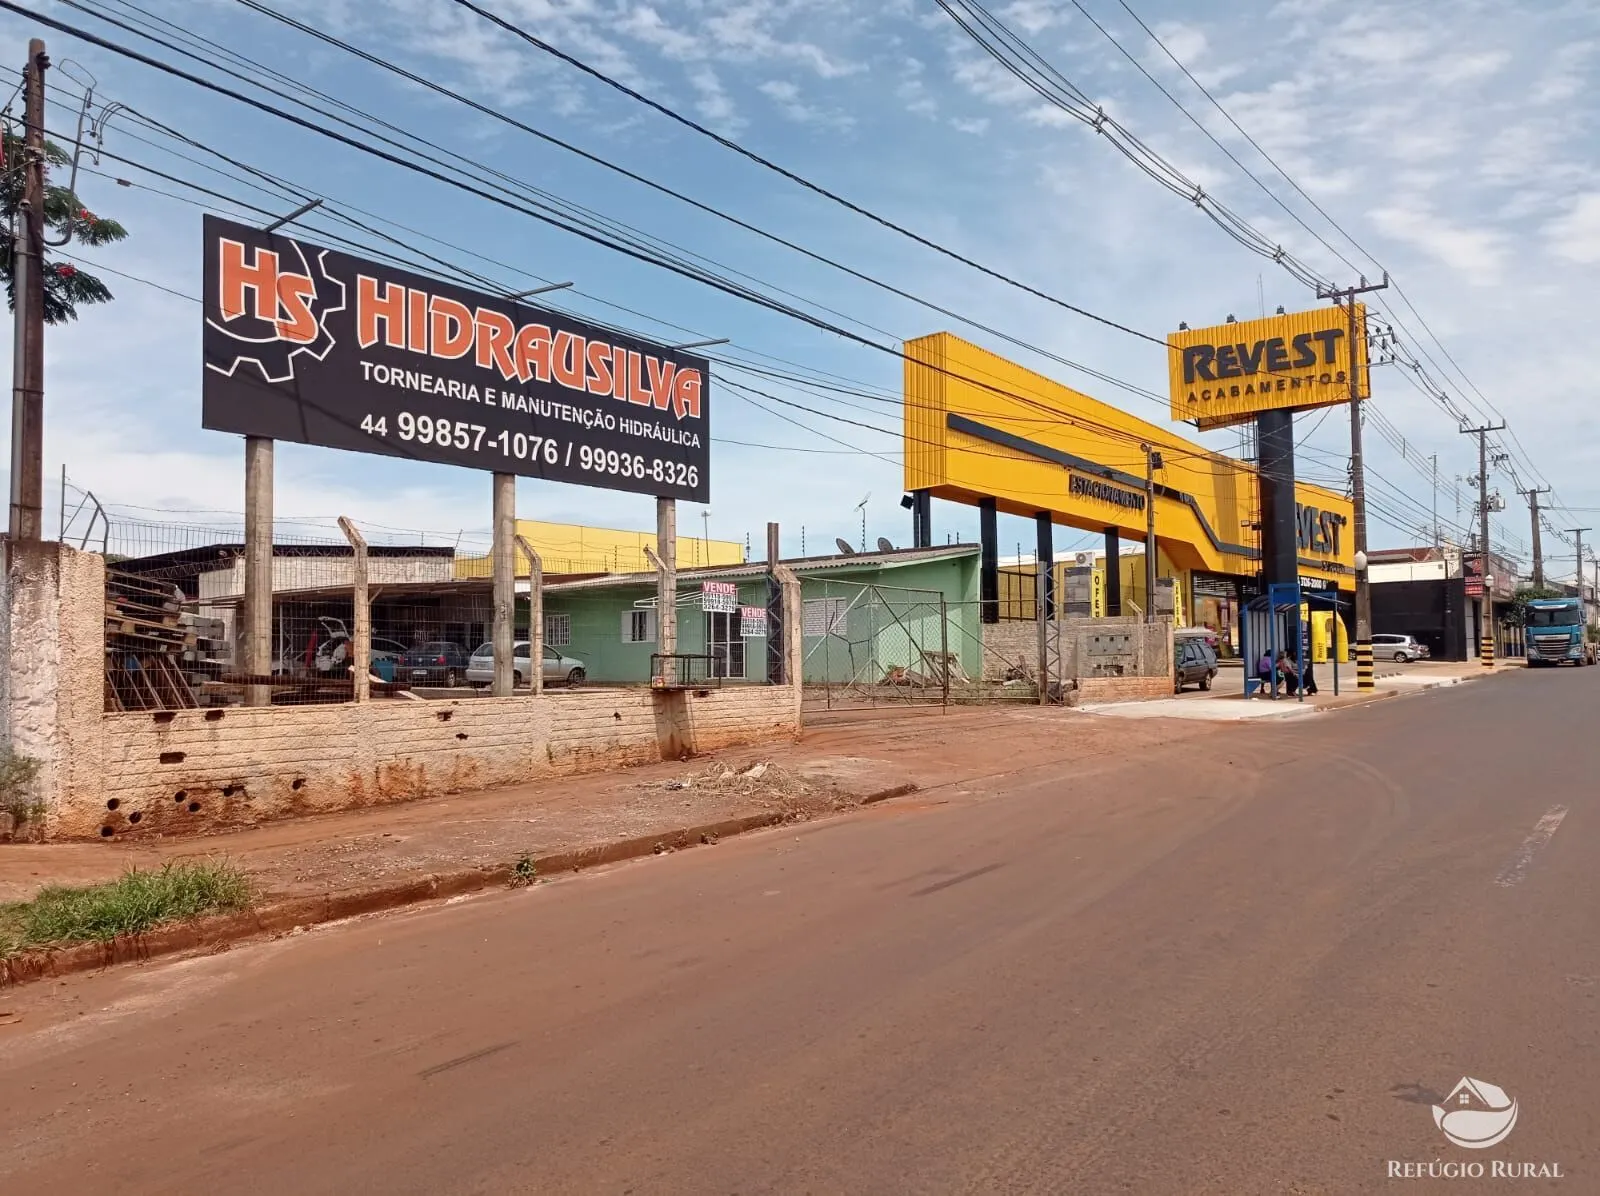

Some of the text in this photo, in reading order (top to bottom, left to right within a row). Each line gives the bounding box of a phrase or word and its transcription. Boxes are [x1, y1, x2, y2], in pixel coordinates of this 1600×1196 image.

[219, 236, 319, 345] HS
[357, 274, 703, 420] HIDRAUSILVA
[1182, 329, 1345, 384] REVEST
[360, 360, 701, 449] TORNEARIA E MANUTENÇÃO HIDRÁULICA
[1187, 371, 1346, 404] ACABAMENTOS
[360, 414, 388, 437] 44
[398, 411, 558, 464] 99857-1076
[580, 445, 699, 488] 99936-8326
[704, 581, 735, 594] VENDE
[741, 607, 767, 618] VENDE
